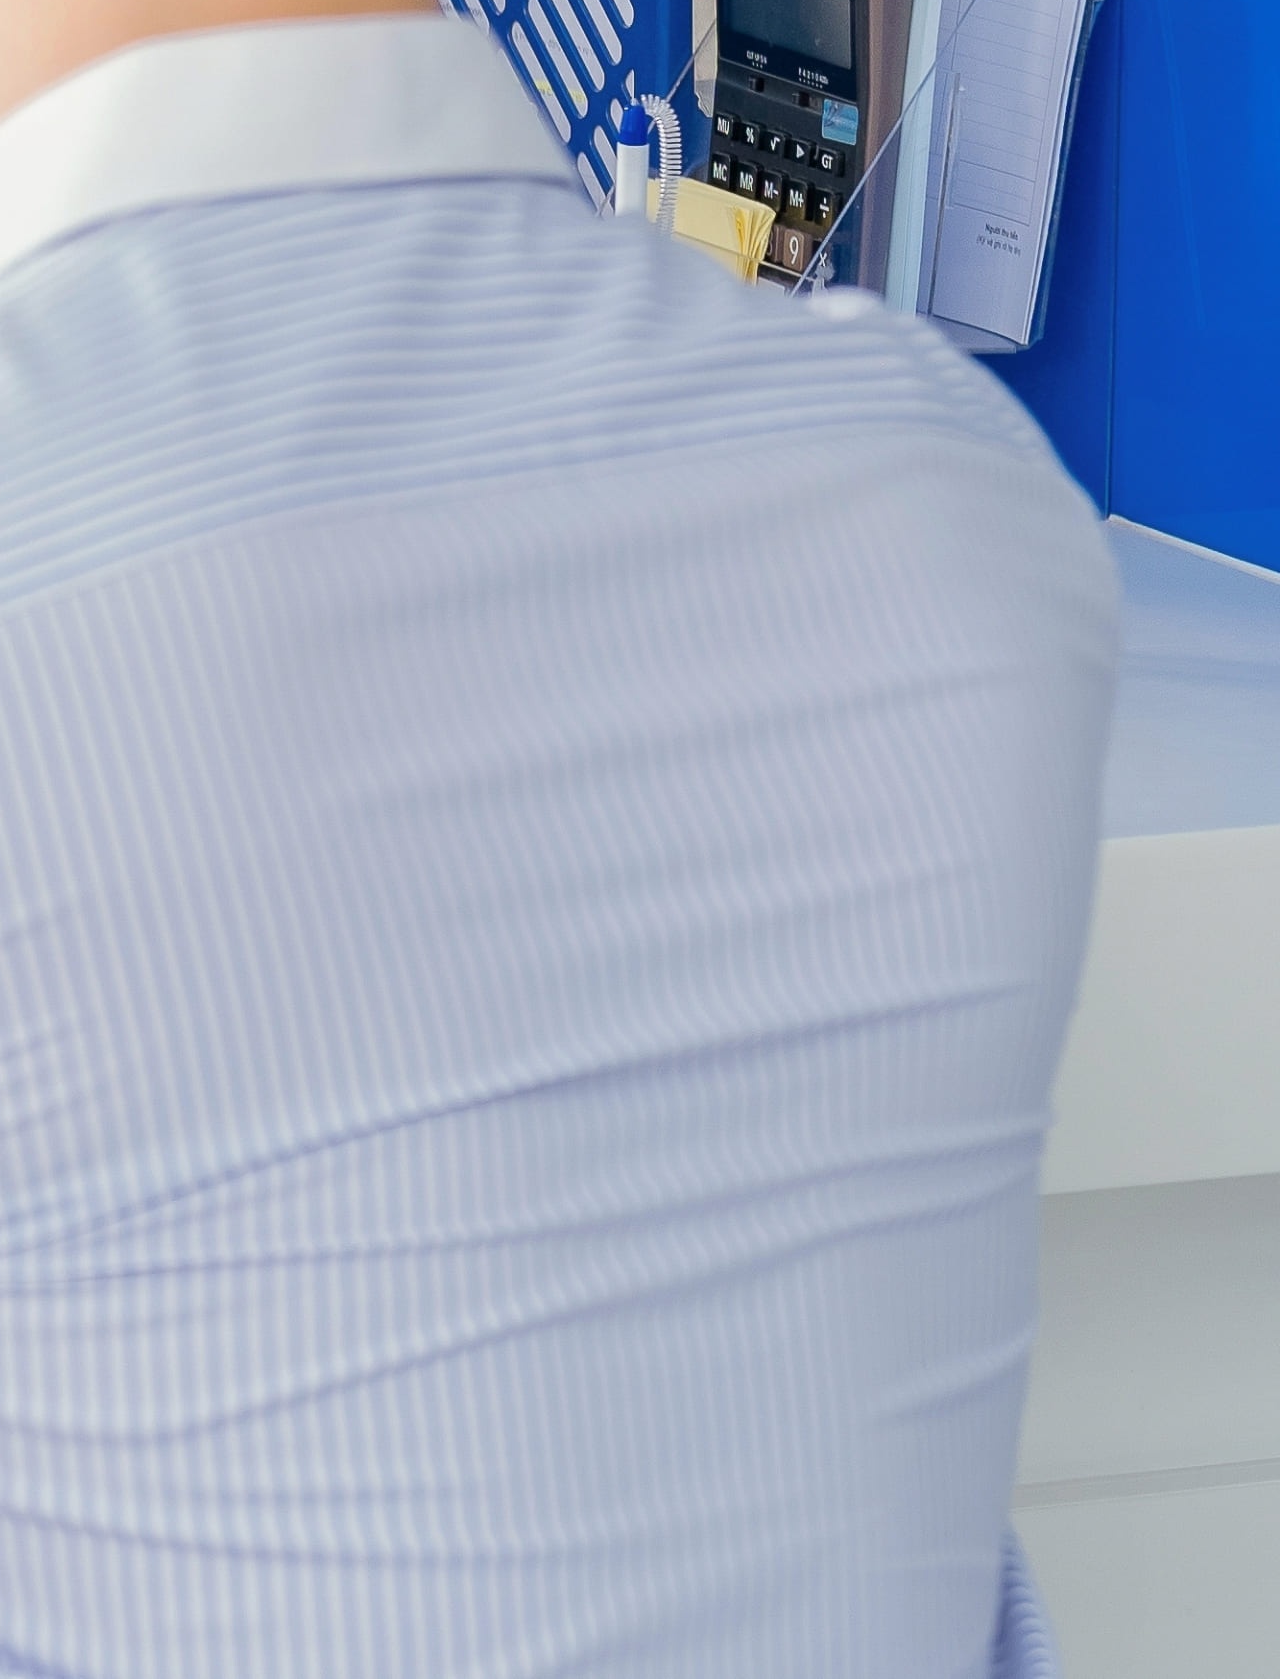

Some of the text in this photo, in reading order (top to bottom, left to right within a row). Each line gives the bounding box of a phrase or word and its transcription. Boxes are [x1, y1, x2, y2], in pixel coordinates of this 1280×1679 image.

[717, 119, 730, 136] MU
[821, 154, 834, 170] GT
[713, 161, 728, 182] MC
[740, 171, 754, 192] MR
[790, 189, 804, 208] M+
[789, 235, 799, 265] 9
